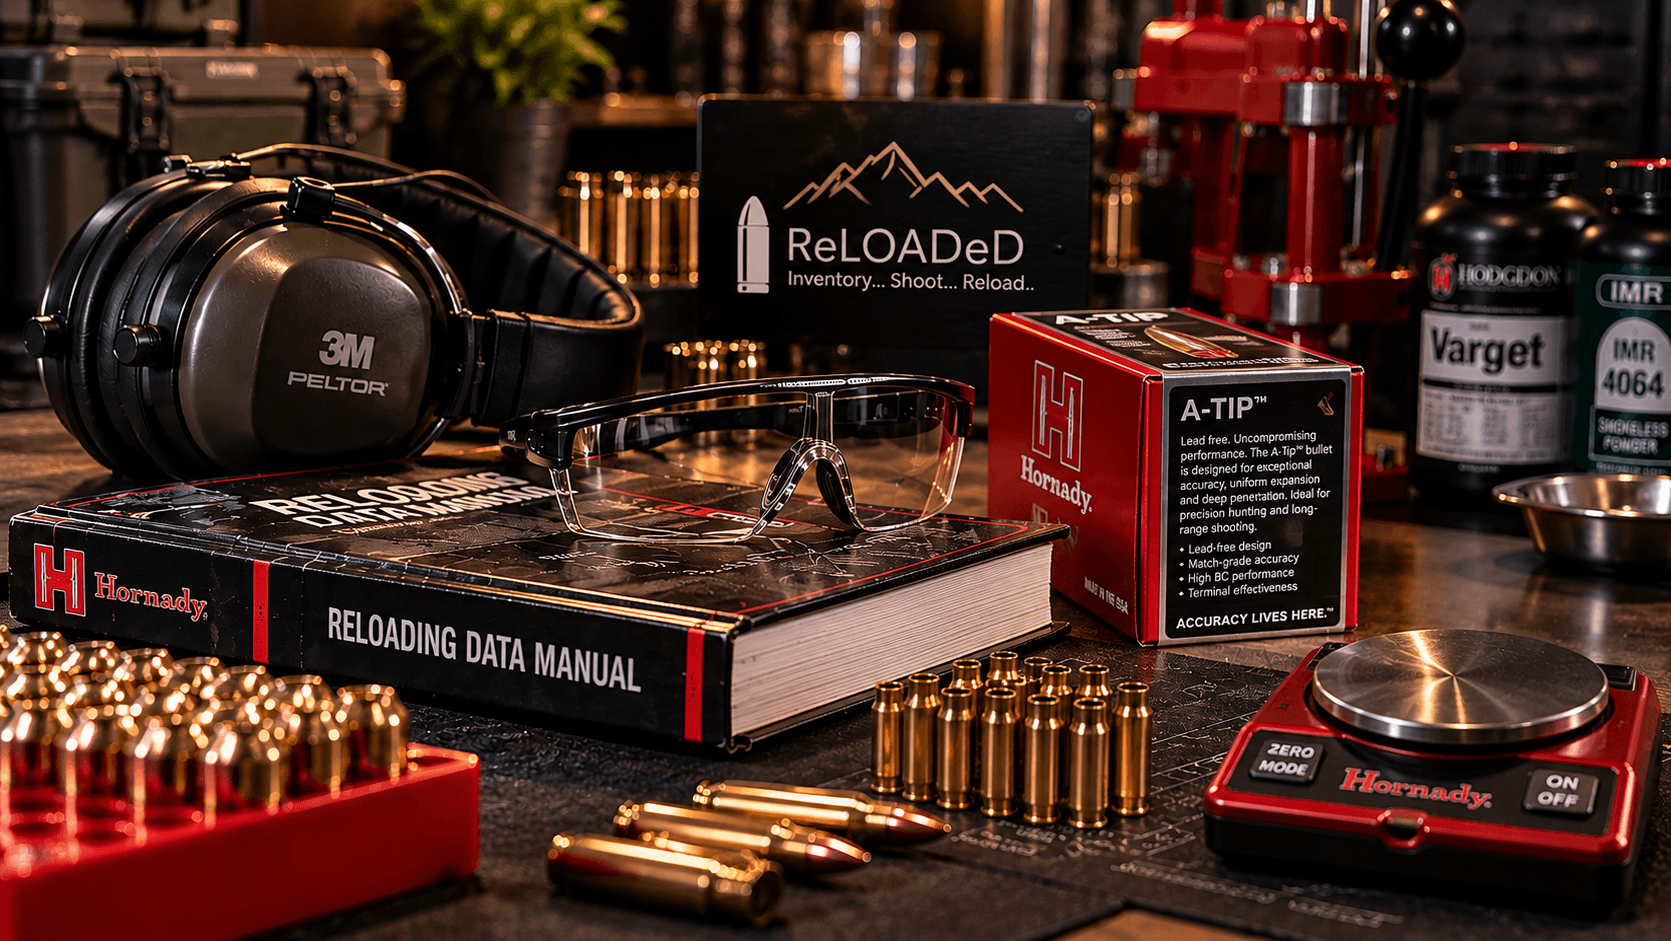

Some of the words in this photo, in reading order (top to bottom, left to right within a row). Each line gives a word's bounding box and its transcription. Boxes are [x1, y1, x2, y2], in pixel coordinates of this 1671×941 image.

[788, 227, 1024, 265] ReLOADeD
[788, 270, 885, 292] Inventory...
[890, 272, 958, 290] Shoot...
[963, 273, 1035, 291] Reload..
[1458, 263, 1560, 287] HODGDON
[1611, 280, 1664, 304] IMR
[1055, 311, 1169, 325] A-TIP
[318, 329, 375, 370] 3M
[1431, 326, 1544, 375] Varget
[1613, 339, 1656, 363] IMR
[1602, 367, 1665, 399] 4064
[1180, 435, 1206, 447] Lead
[1208, 434, 1231, 445] free.
[1233, 430, 1317, 444] Uncompromising
[1180, 449, 1248, 464] performance.
[1249, 446, 1269, 458] The
[1305, 443, 1333, 455] bullet
[1180, 465, 1189, 476] is
[1191, 462, 1238, 477] designed
[1240, 462, 1255, 473] for
[1256, 458, 1313, 474] exceptional
[1180, 480, 1227, 492] accuracy,
[1229, 476, 1268, 488] uniform
[1270, 473, 1320, 489] expansion
[1180, 494, 1199, 506] and
[1201, 493, 1228, 507] deep
[1290, 487, 1315, 500] Ideal
[1316, 487, 1331, 499] for
[1180, 508, 1226, 523] precision
[1228, 505, 1267, 519] hunting
[1269, 503, 1290, 516] and
[1291, 503, 1318, 516] long-
[1180, 525, 1209, 537] range
[1211, 520, 1258, 534] shooting.
[1188, 542, 1236, 555] Lead-free
[1238, 540, 1272, 553] design
[1188, 555, 1252, 570] Match-grade
[1254, 554, 1300, 565] accuracy
[1188, 572, 1212, 586] High
[1214, 571, 1230, 582] BC
[1231, 569, 1295, 583] performance
[1188, 585, 1231, 598] Terminal
[1233, 582, 1298, 595] effectiveness
[1176, 613, 1249, 630] ACCURACY
[1251, 610, 1288, 624] LIVES
[328, 606, 457, 660] RELOADING
[466, 629, 526, 673] DATA
[534, 641, 642, 693] MANUAL
[1266, 742, 1315, 760] ZERO
[1258, 759, 1309, 777] MODE
[1545, 774, 1580, 791] ON
[1537, 790, 1579, 808] OFF
